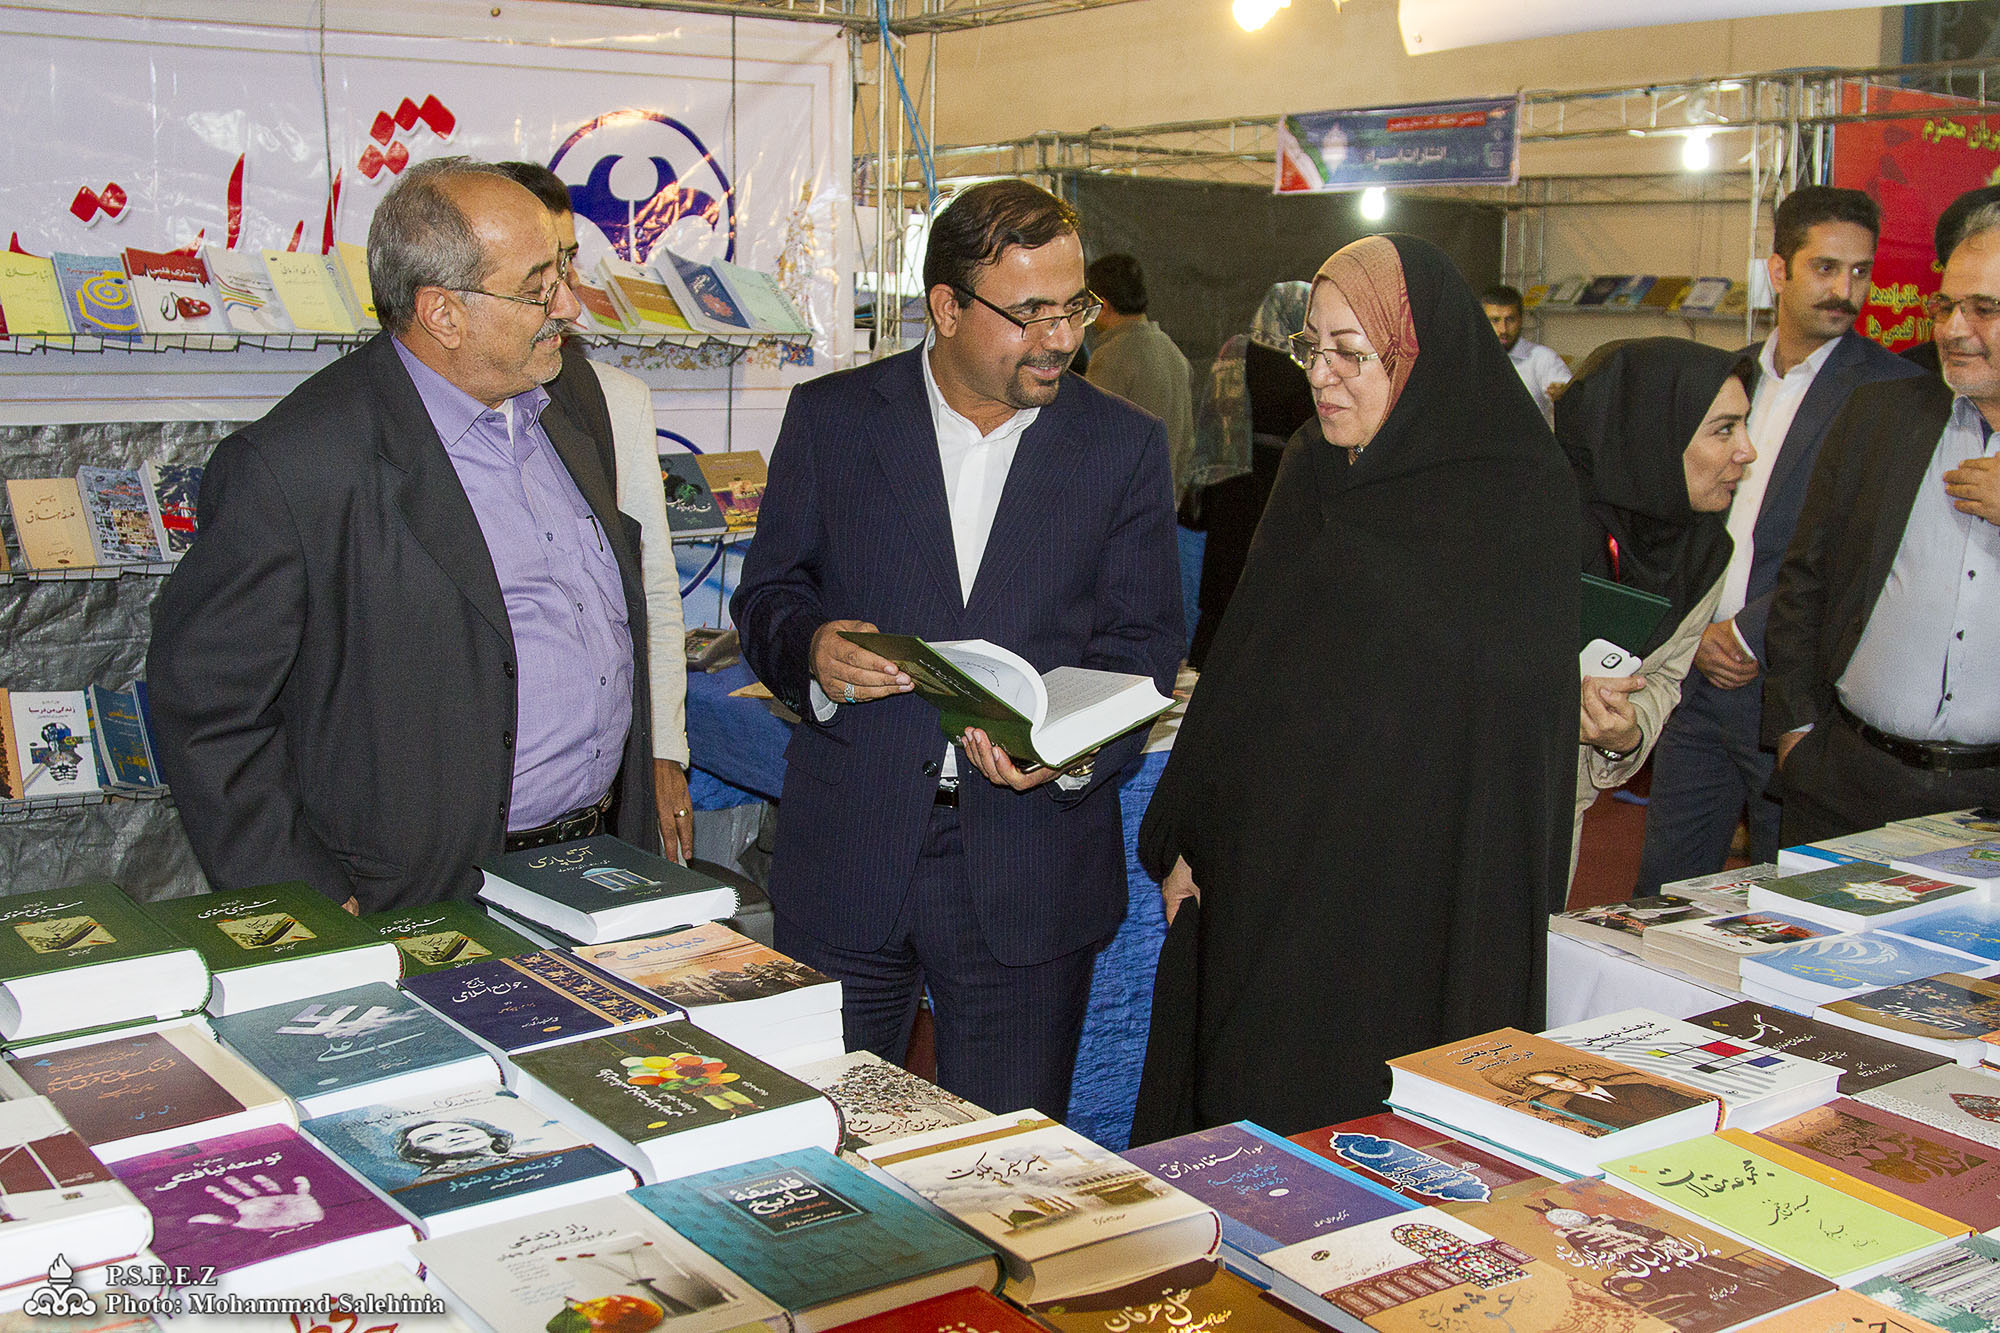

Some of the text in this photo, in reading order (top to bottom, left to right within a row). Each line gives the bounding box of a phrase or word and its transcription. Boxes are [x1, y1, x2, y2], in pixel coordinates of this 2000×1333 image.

[528, 855, 569, 870] پارسی
[26, 901, 83, 918] مثنوی
[198, 899, 278, 919] مثنوی معنوی
[398, 917, 446, 933] مثنوی
[616, 937, 707, 961] دیپلماسی
[452, 980, 529, 1003] جوامع اسلامی
[462, 977, 486, 989] تاریخ
[1583, 1021, 1656, 1047] فرهنگ توصیفی
[1453, 1041, 1514, 1066] شریعتی
[945, 1151, 989, 1182] ملکوت
[1656, 1158, 1777, 1199] مجموعه مقالات
[448, 1174, 492, 1193] دشوار
[748, 1188, 821, 1216] تاریخ
[508, 1223, 589, 1250] راز زندگی
[1103, 1303, 1163, 1333] عرفان
[1161, 1287, 1194, 1327] عقل
